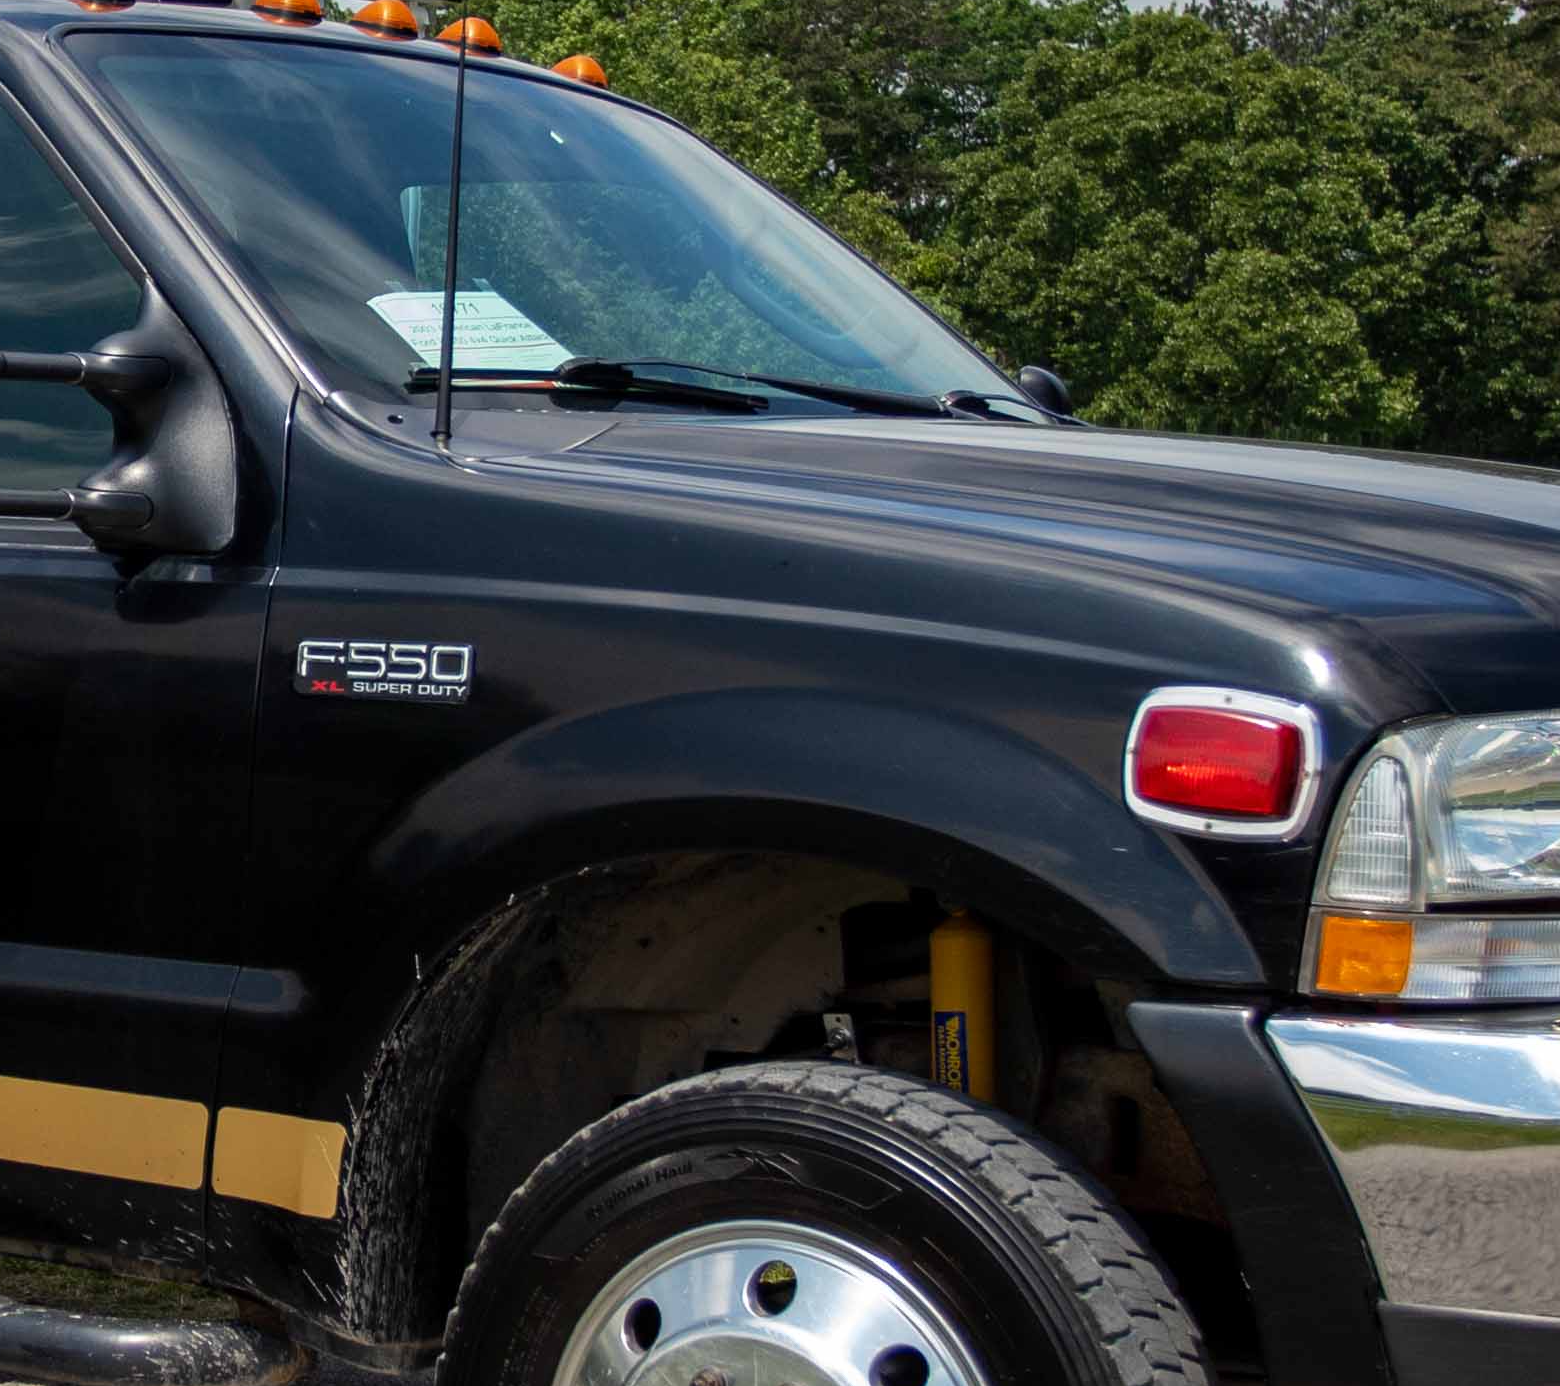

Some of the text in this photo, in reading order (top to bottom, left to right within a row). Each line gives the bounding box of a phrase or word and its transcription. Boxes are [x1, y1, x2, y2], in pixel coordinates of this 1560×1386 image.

[310, 679, 467, 697] XL SUPER DUTY
